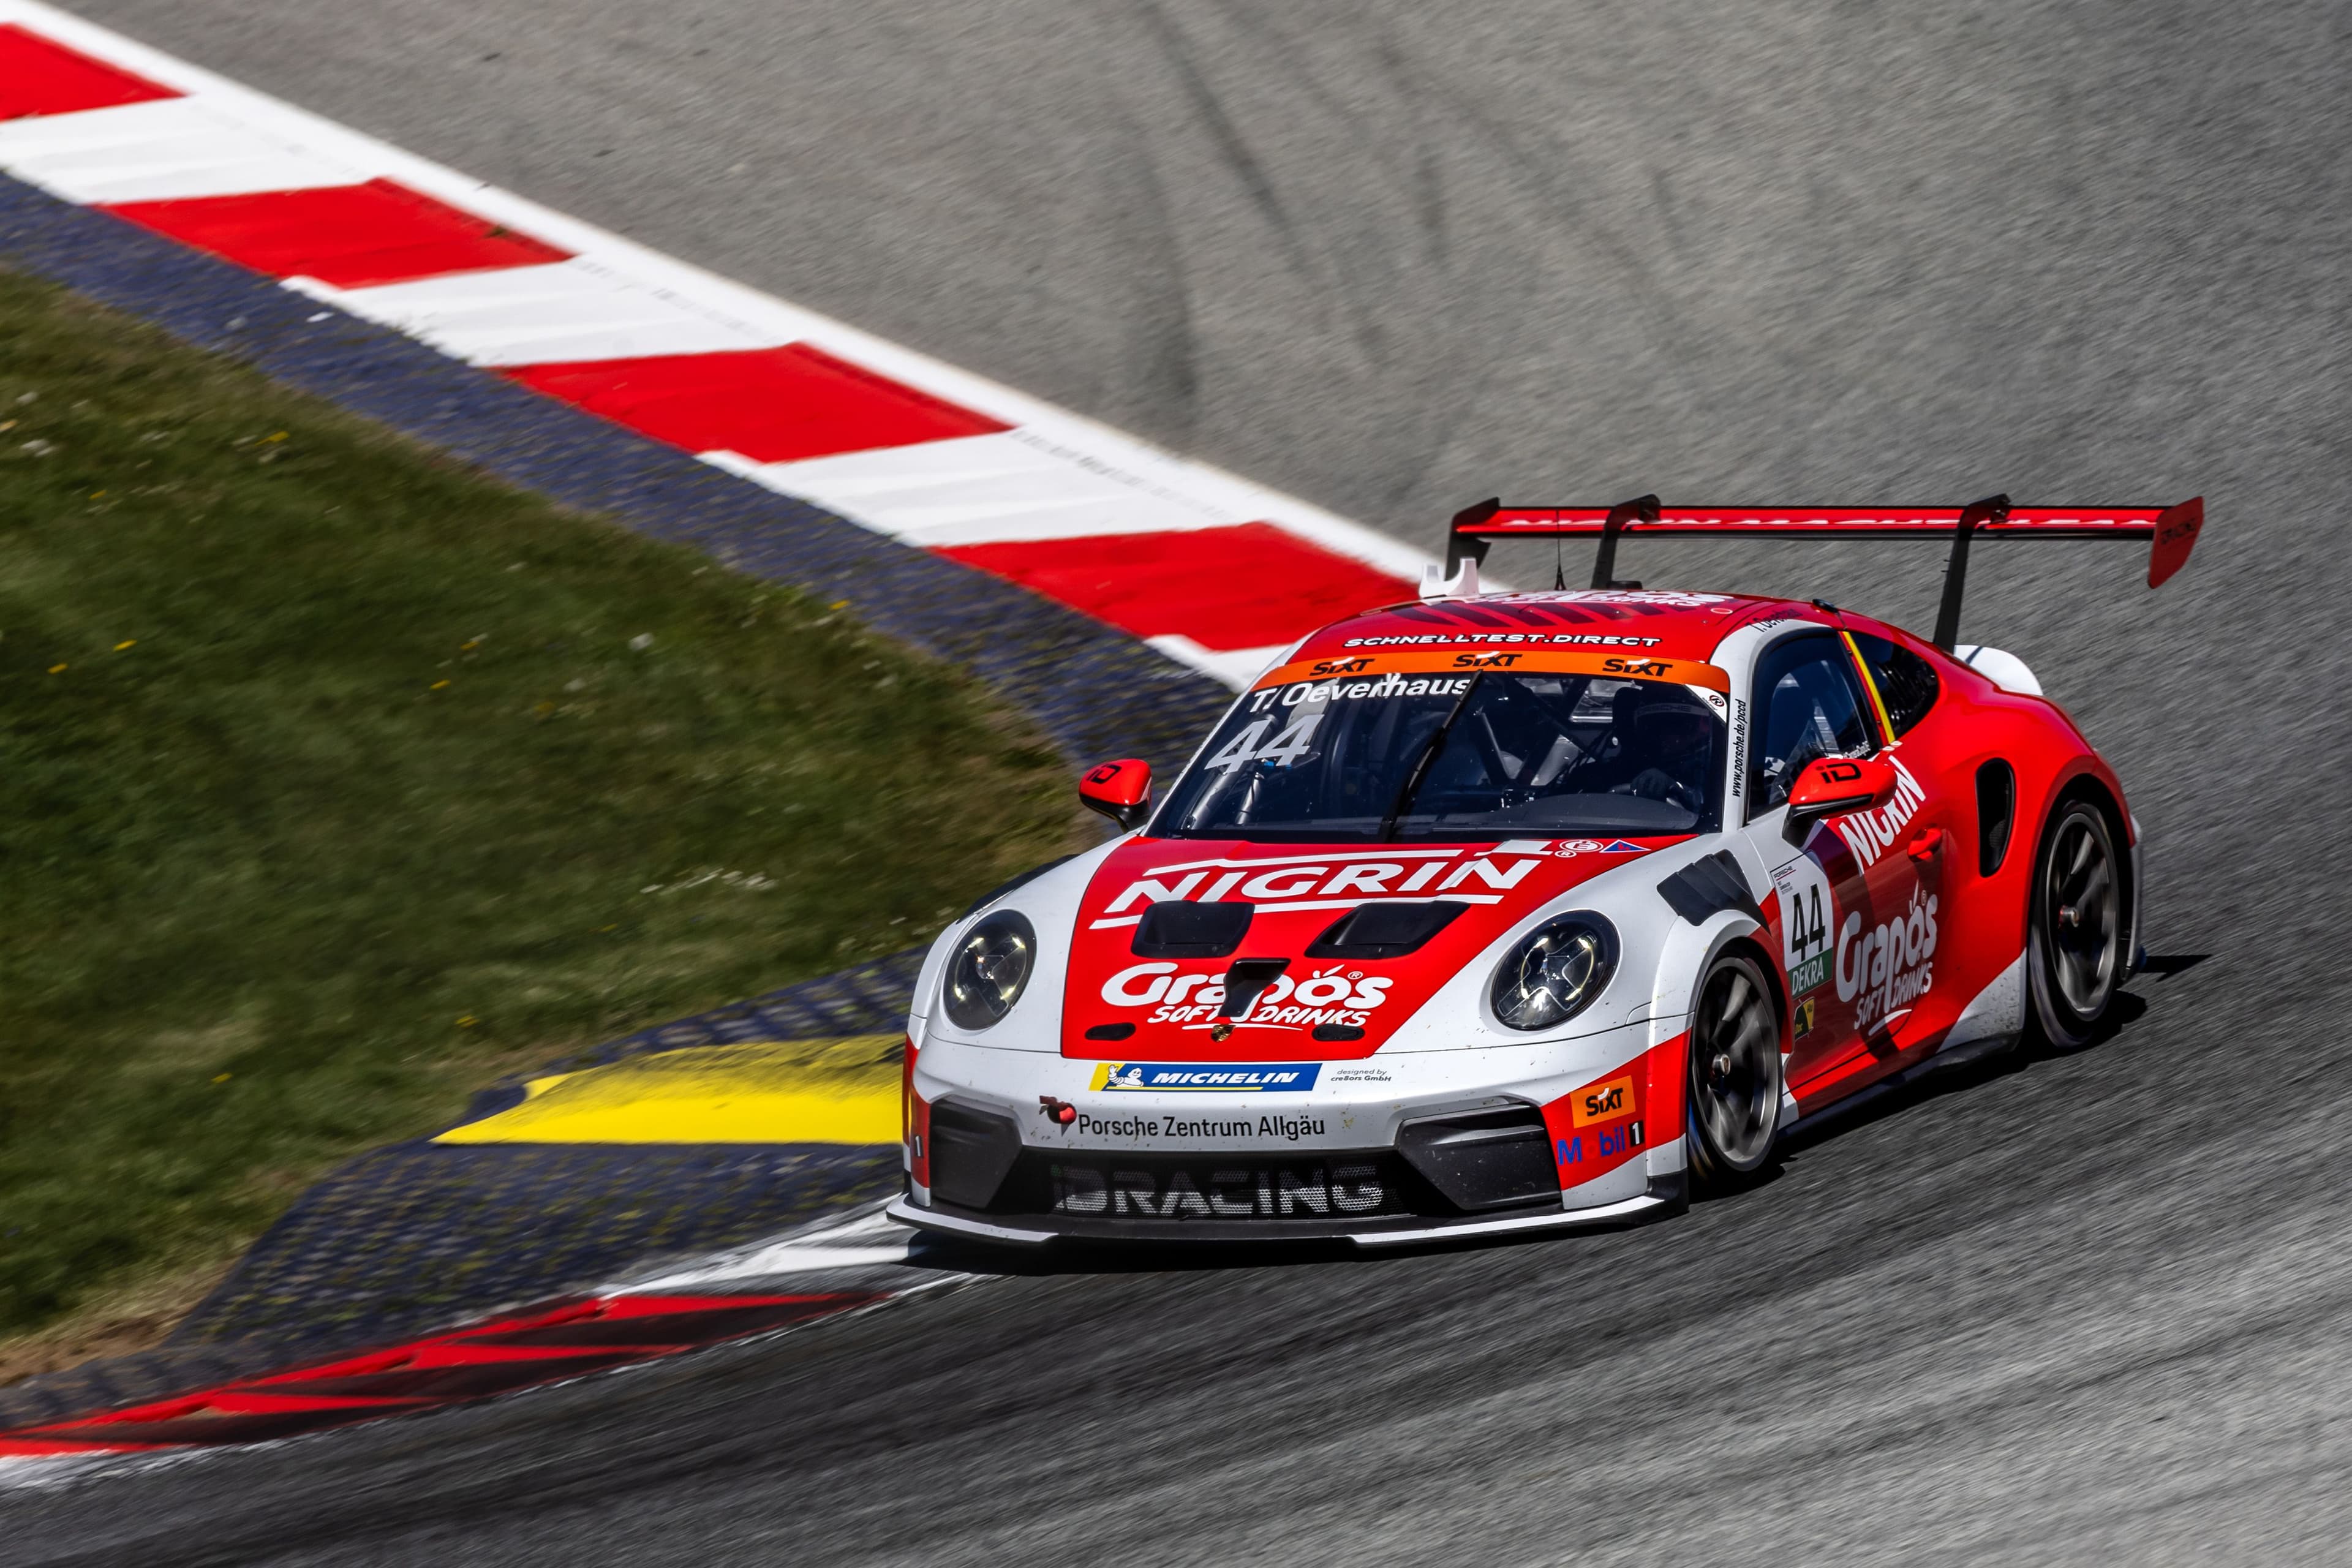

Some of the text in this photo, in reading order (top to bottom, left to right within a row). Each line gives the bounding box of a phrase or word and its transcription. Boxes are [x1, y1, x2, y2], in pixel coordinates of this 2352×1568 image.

[1344, 633, 1662, 648] SCHNELLTEST.DIRECT
[1250, 673, 1470, 712] T. Oeverhaus
[1204, 714, 1324, 775] 44
[1732, 698, 1747, 797] www.porsche.de/pccd
[1104, 859, 1540, 913] NIGRIN
[1790, 883, 1826, 962] 44
[1792, 956, 1824, 995] DEKRA
[1854, 962, 1933, 1030] SOFT DRINKS
[1147, 1005, 1371, 1027] SOFT DRINKS
[1152, 1072, 1298, 1084] MICHELIN
[1079, 1114, 1325, 1140] Porsche Zentrum Allgäu
